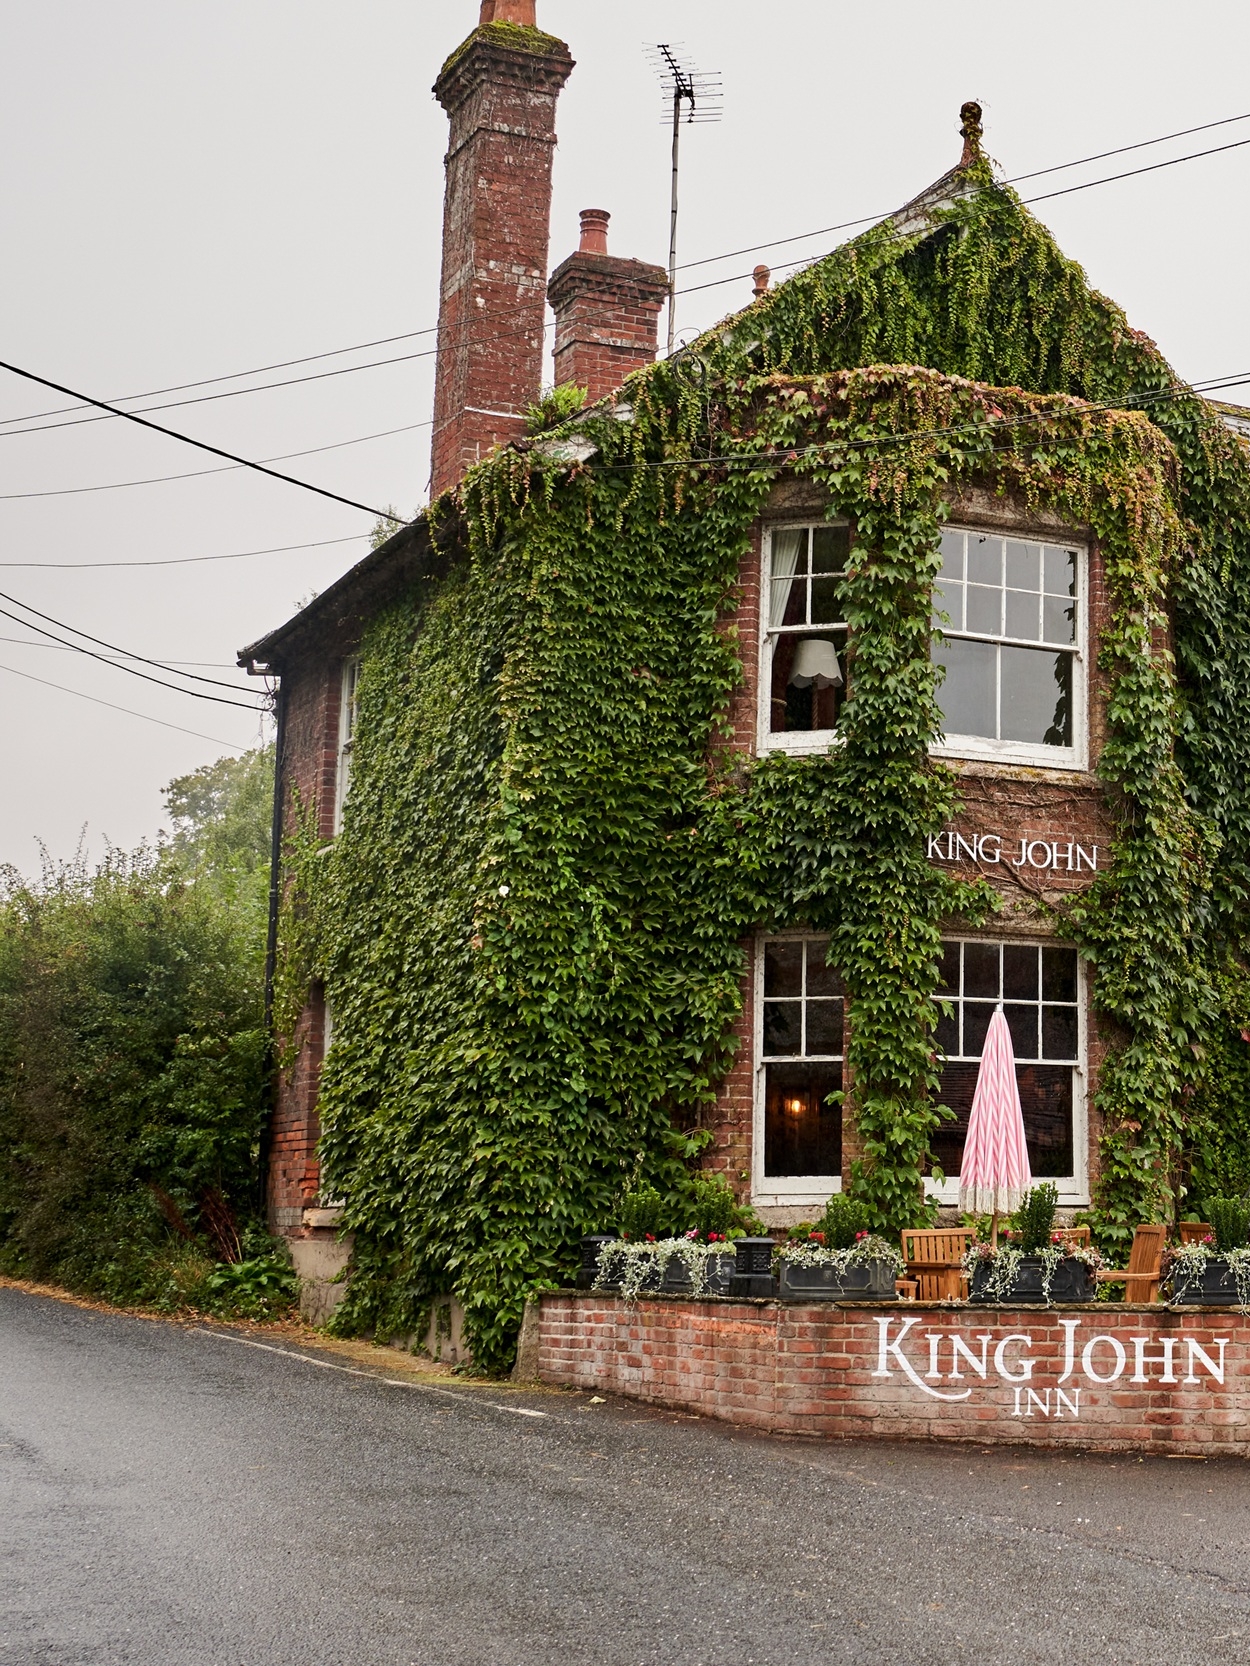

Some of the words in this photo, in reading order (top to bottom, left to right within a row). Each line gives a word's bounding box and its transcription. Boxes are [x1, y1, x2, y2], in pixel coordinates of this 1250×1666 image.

[926, 831, 1001, 863] KING
[1012, 838, 1098, 872] JOHN
[871, 1316, 1035, 1400] KING
[1057, 1319, 1230, 1384] JOHN
[1011, 1386, 1082, 1417] INN
